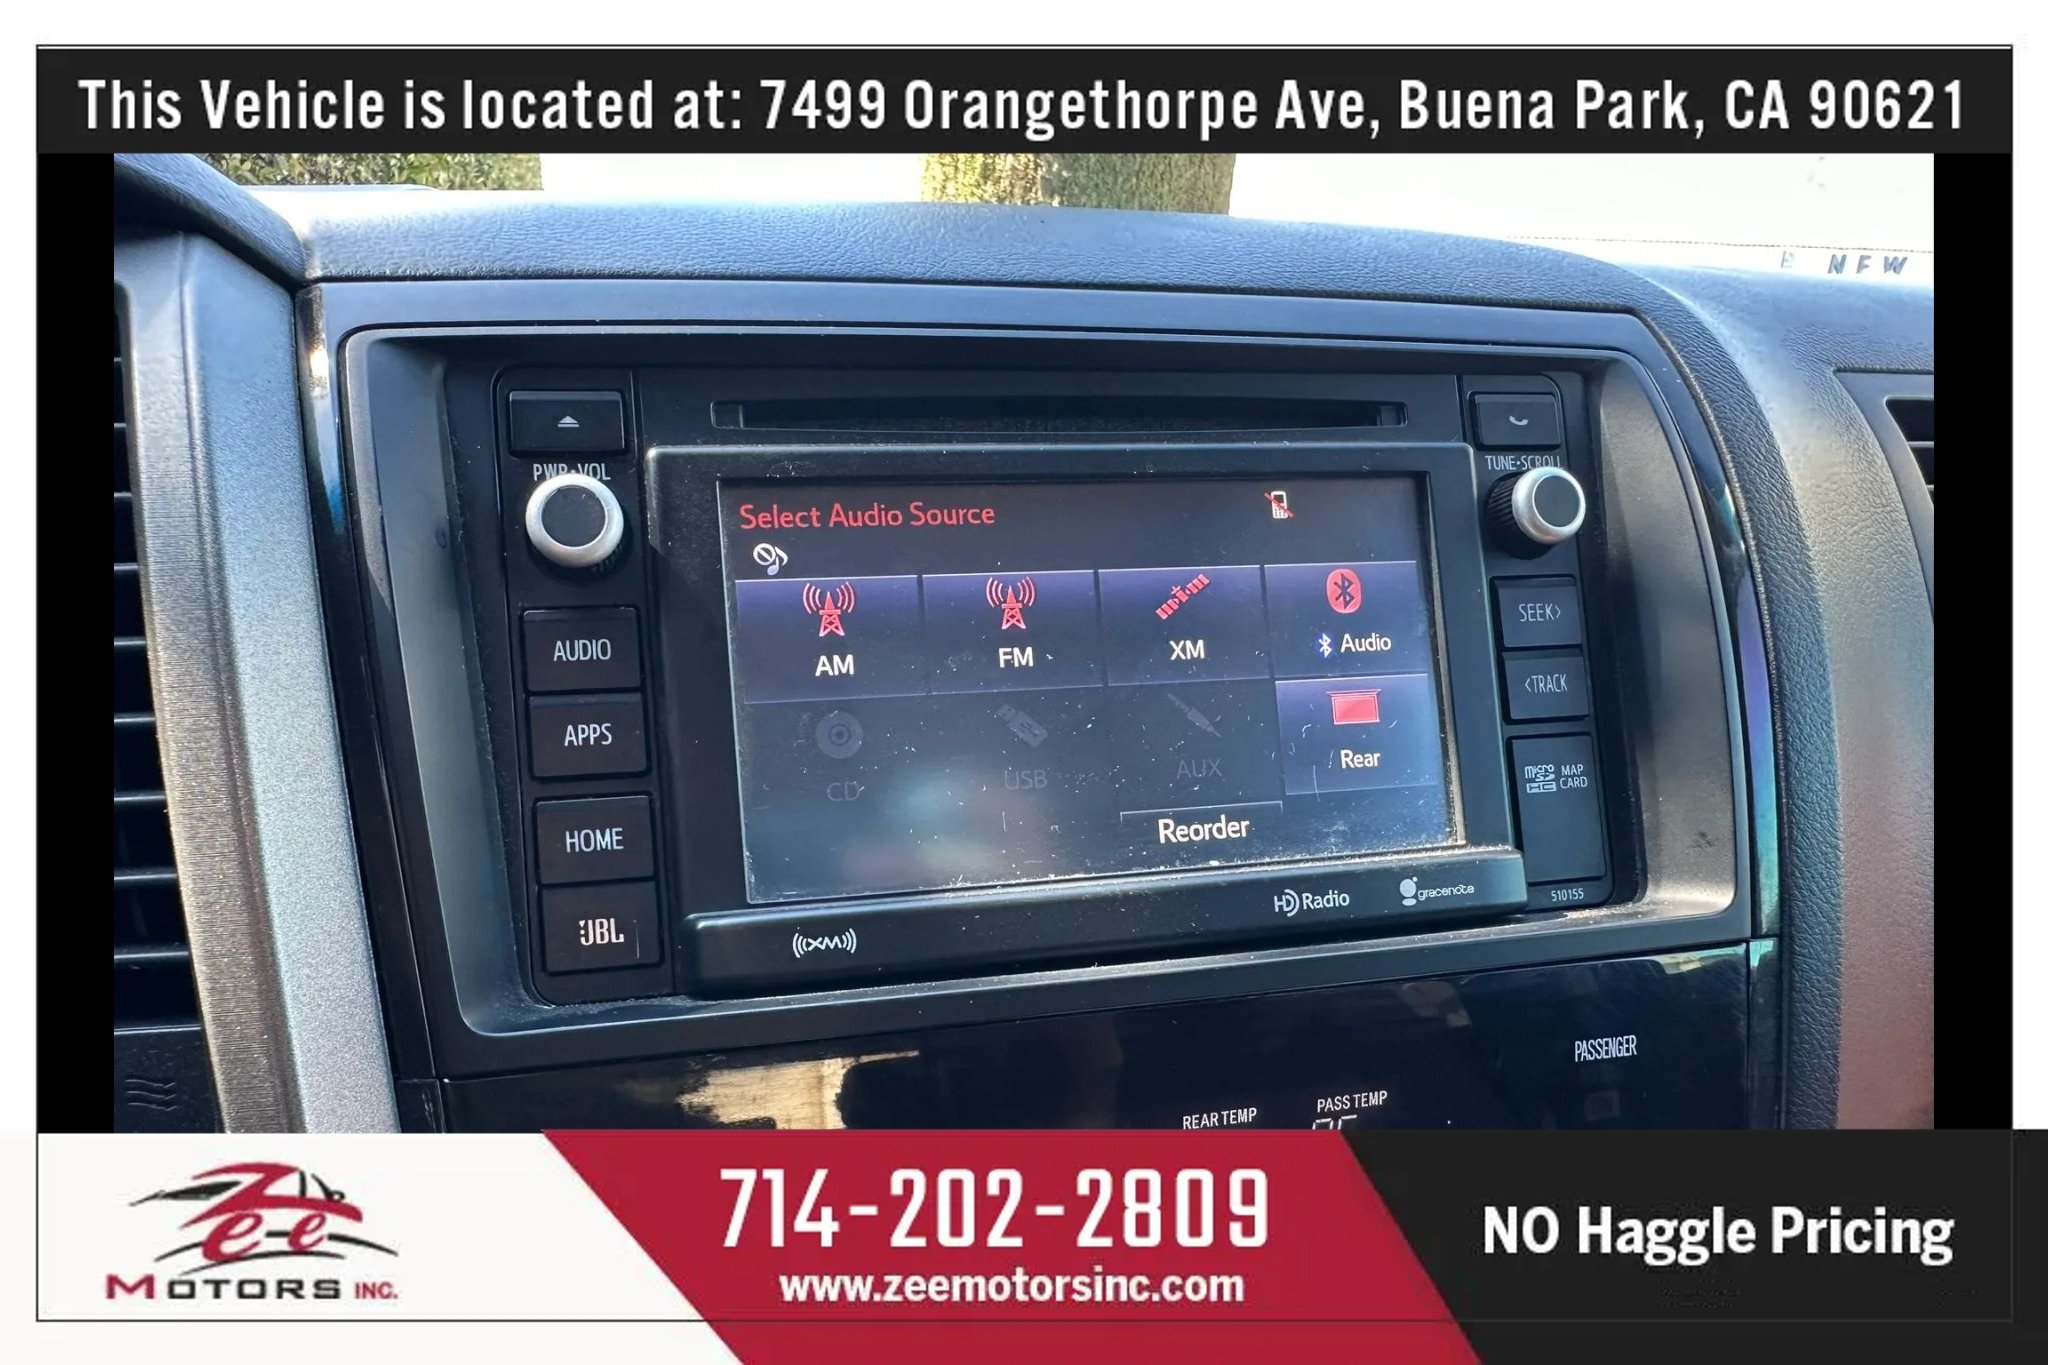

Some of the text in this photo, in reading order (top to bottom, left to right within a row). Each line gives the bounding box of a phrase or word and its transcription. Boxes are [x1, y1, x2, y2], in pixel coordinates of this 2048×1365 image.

[739, 501, 995, 530] Select Audio Source
[553, 638, 611, 662] AUDIO
[1169, 639, 1206, 661] XM
[1340, 632, 1392, 655] Audio
[815, 653, 855, 677] AM
[998, 646, 1034, 669] FM
[564, 722, 613, 747] APPS
[1177, 758, 1223, 779] AUX
[1340, 749, 1382, 769] Rear
[1561, 763, 1584, 776] MAP
[1005, 769, 1048, 790] USB
[1559, 776, 1588, 789] CARD
[827, 782, 859, 801] CD
[565, 827, 624, 853] HOME
[1157, 815, 1250, 844] Reorder
[1273, 888, 1350, 917] HD Radio
[1417, 884, 1475, 901] gracenote
[1551, 887, 1585, 902] 510155
[578, 917, 625, 947] JBL
[1574, 1034, 1638, 1062] PASSENGER
[1317, 1090, 1388, 1113] PASS TEMP
[1182, 1107, 1258, 1130] REAR TEMP
